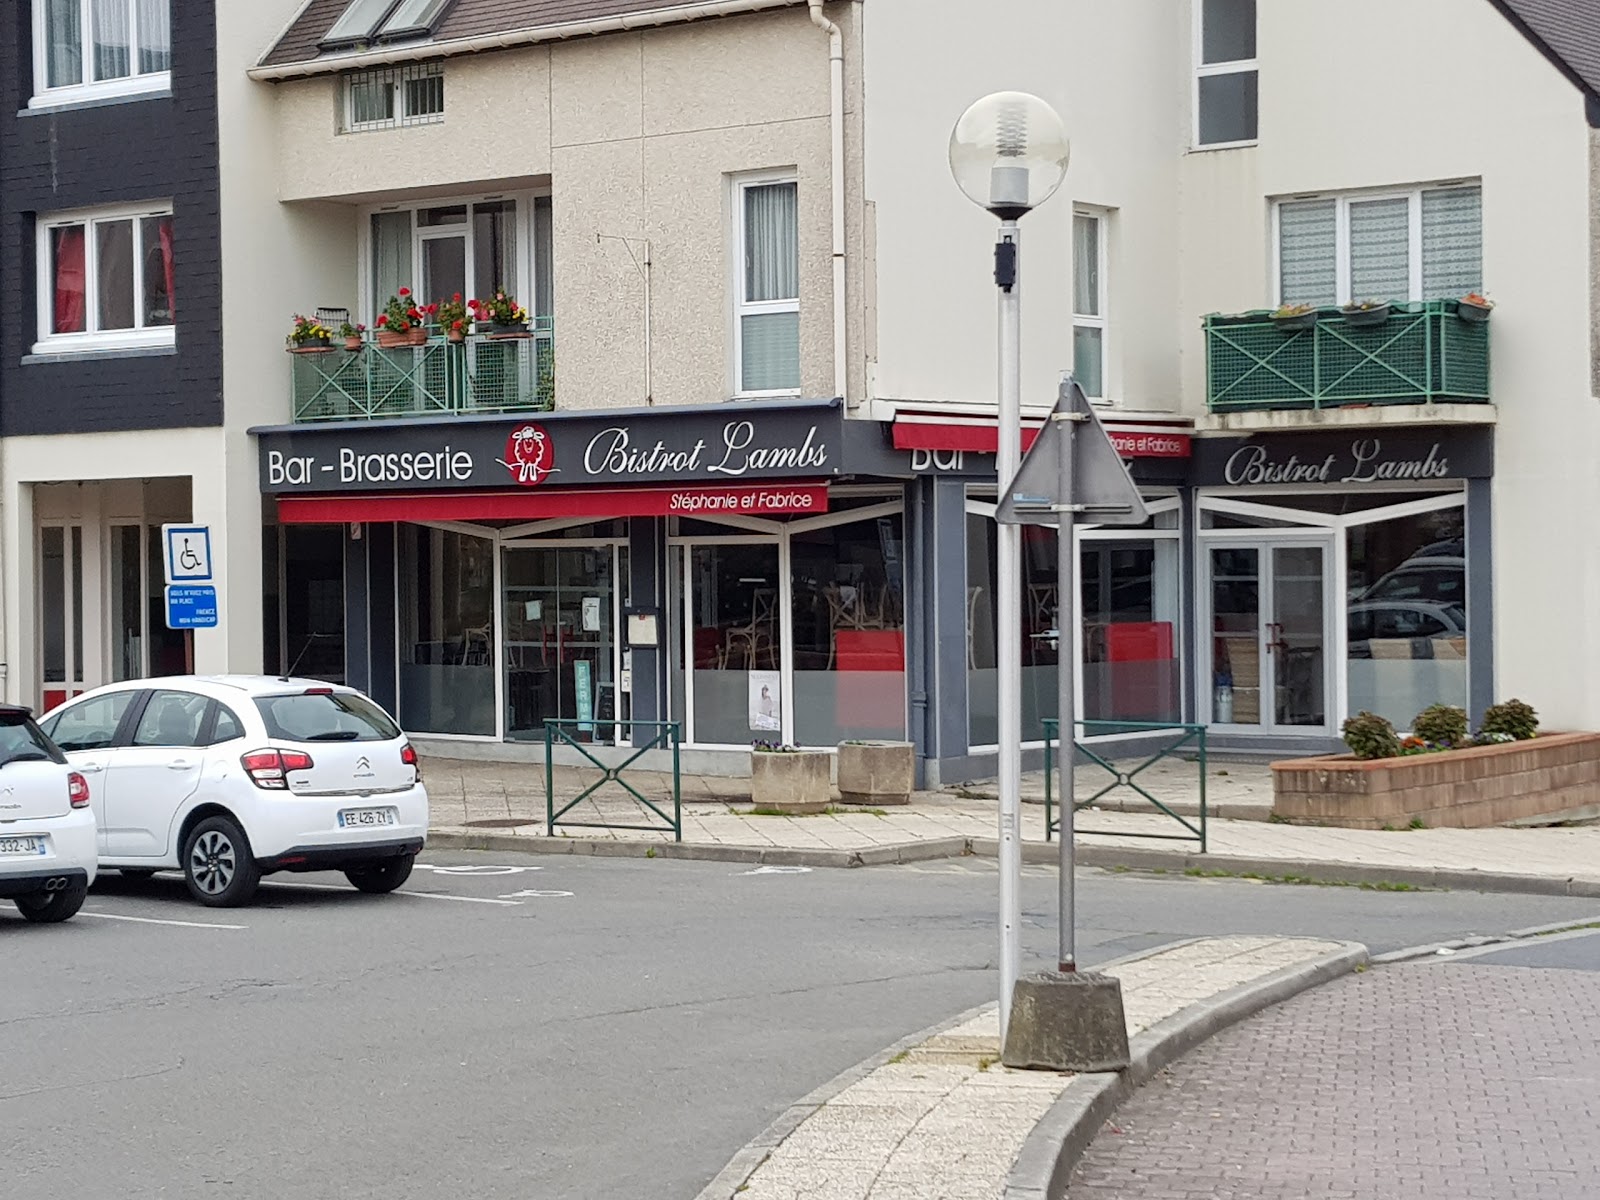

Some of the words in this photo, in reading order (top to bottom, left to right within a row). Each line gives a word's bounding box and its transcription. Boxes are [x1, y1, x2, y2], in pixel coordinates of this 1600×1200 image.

[268, 450, 314, 485] Bar
[339, 446, 474, 482] Brasserie
[583, 427, 706, 475] Bistrot
[706, 421, 828, 475] Lambs
[1224, 445, 1336, 485] Bistrot
[1340, 438, 1449, 483] Lambs
[669, 492, 738, 511] Stéphanie
[740, 493, 756, 507] et
[758, 491, 813, 508] Fabrice
